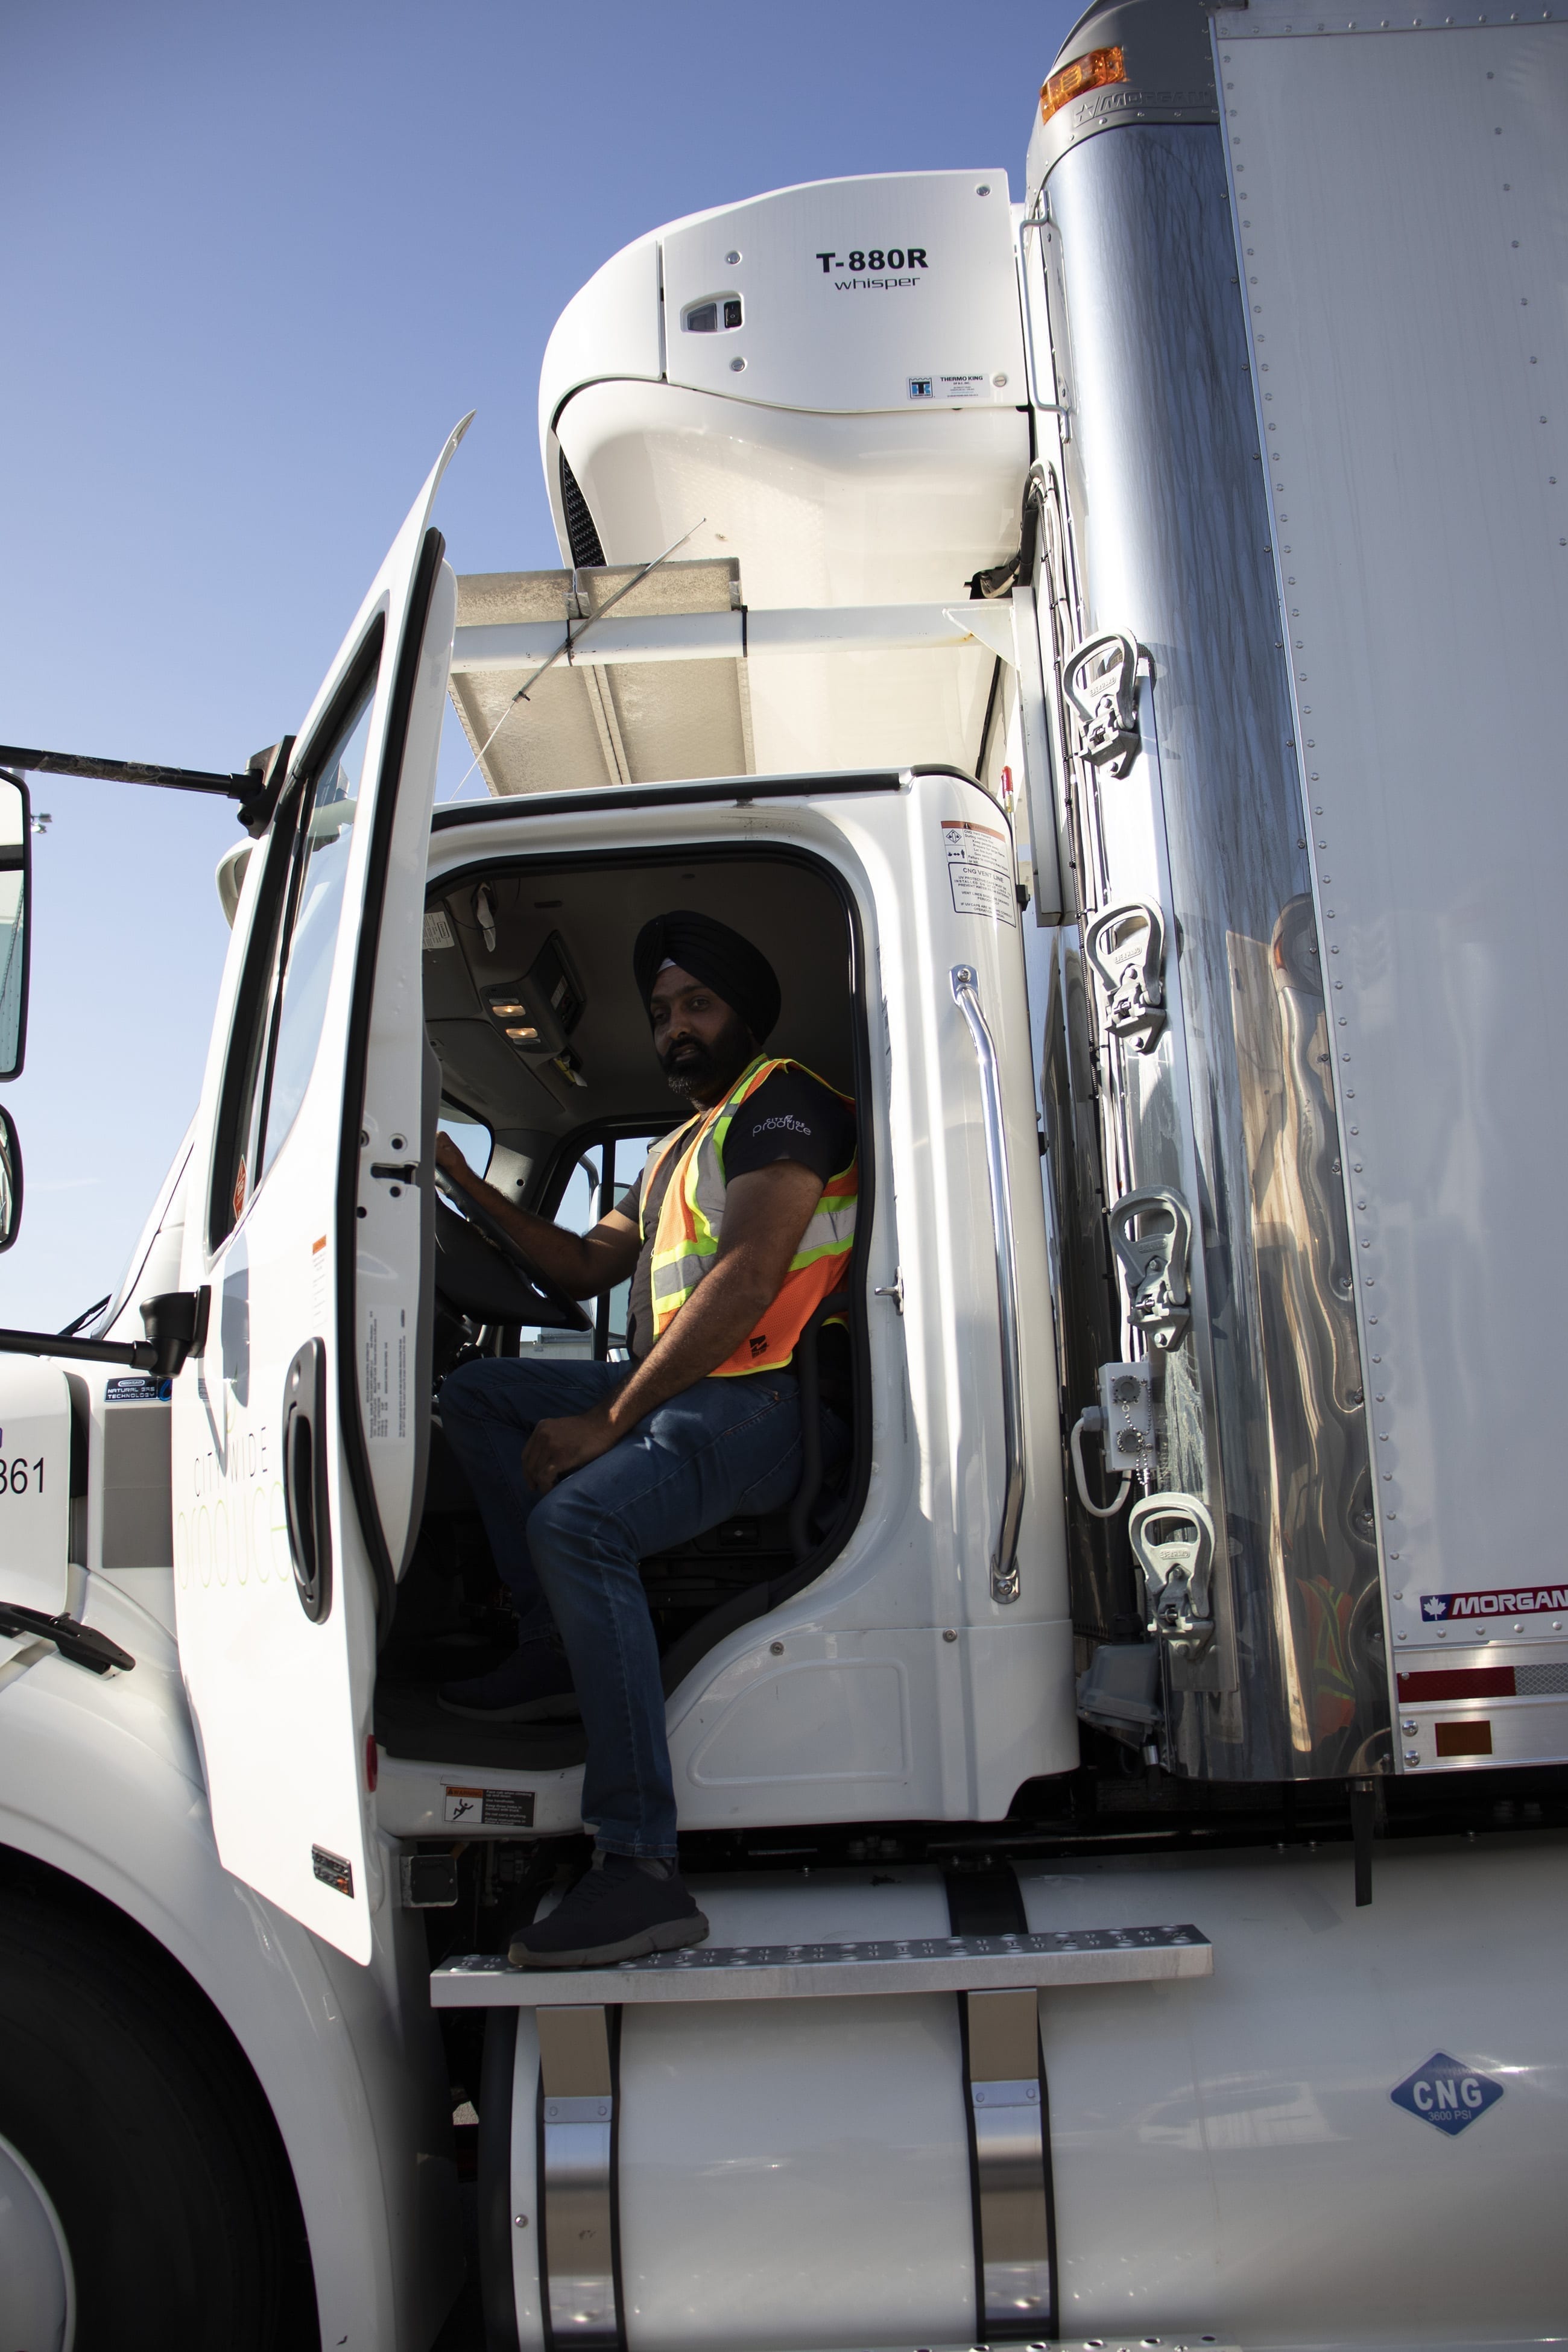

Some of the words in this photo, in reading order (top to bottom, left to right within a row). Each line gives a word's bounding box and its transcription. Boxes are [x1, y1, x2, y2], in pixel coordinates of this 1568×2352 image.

[816, 248, 929, 273] T-880R
[835, 277, 920, 290] whisper
[977, 870, 993, 878] VENT
[993, 873, 1004, 883] LINE
[752, 1114, 811, 1137] produce
[227, 1426, 269, 1484] WIDE
[1452, 1590, 1568, 1616] MORGAN
[1413, 2078, 1483, 2111] CNG
[1428, 2111, 1452, 2122] 3600
[1454, 2110, 1472, 2120] PSI
